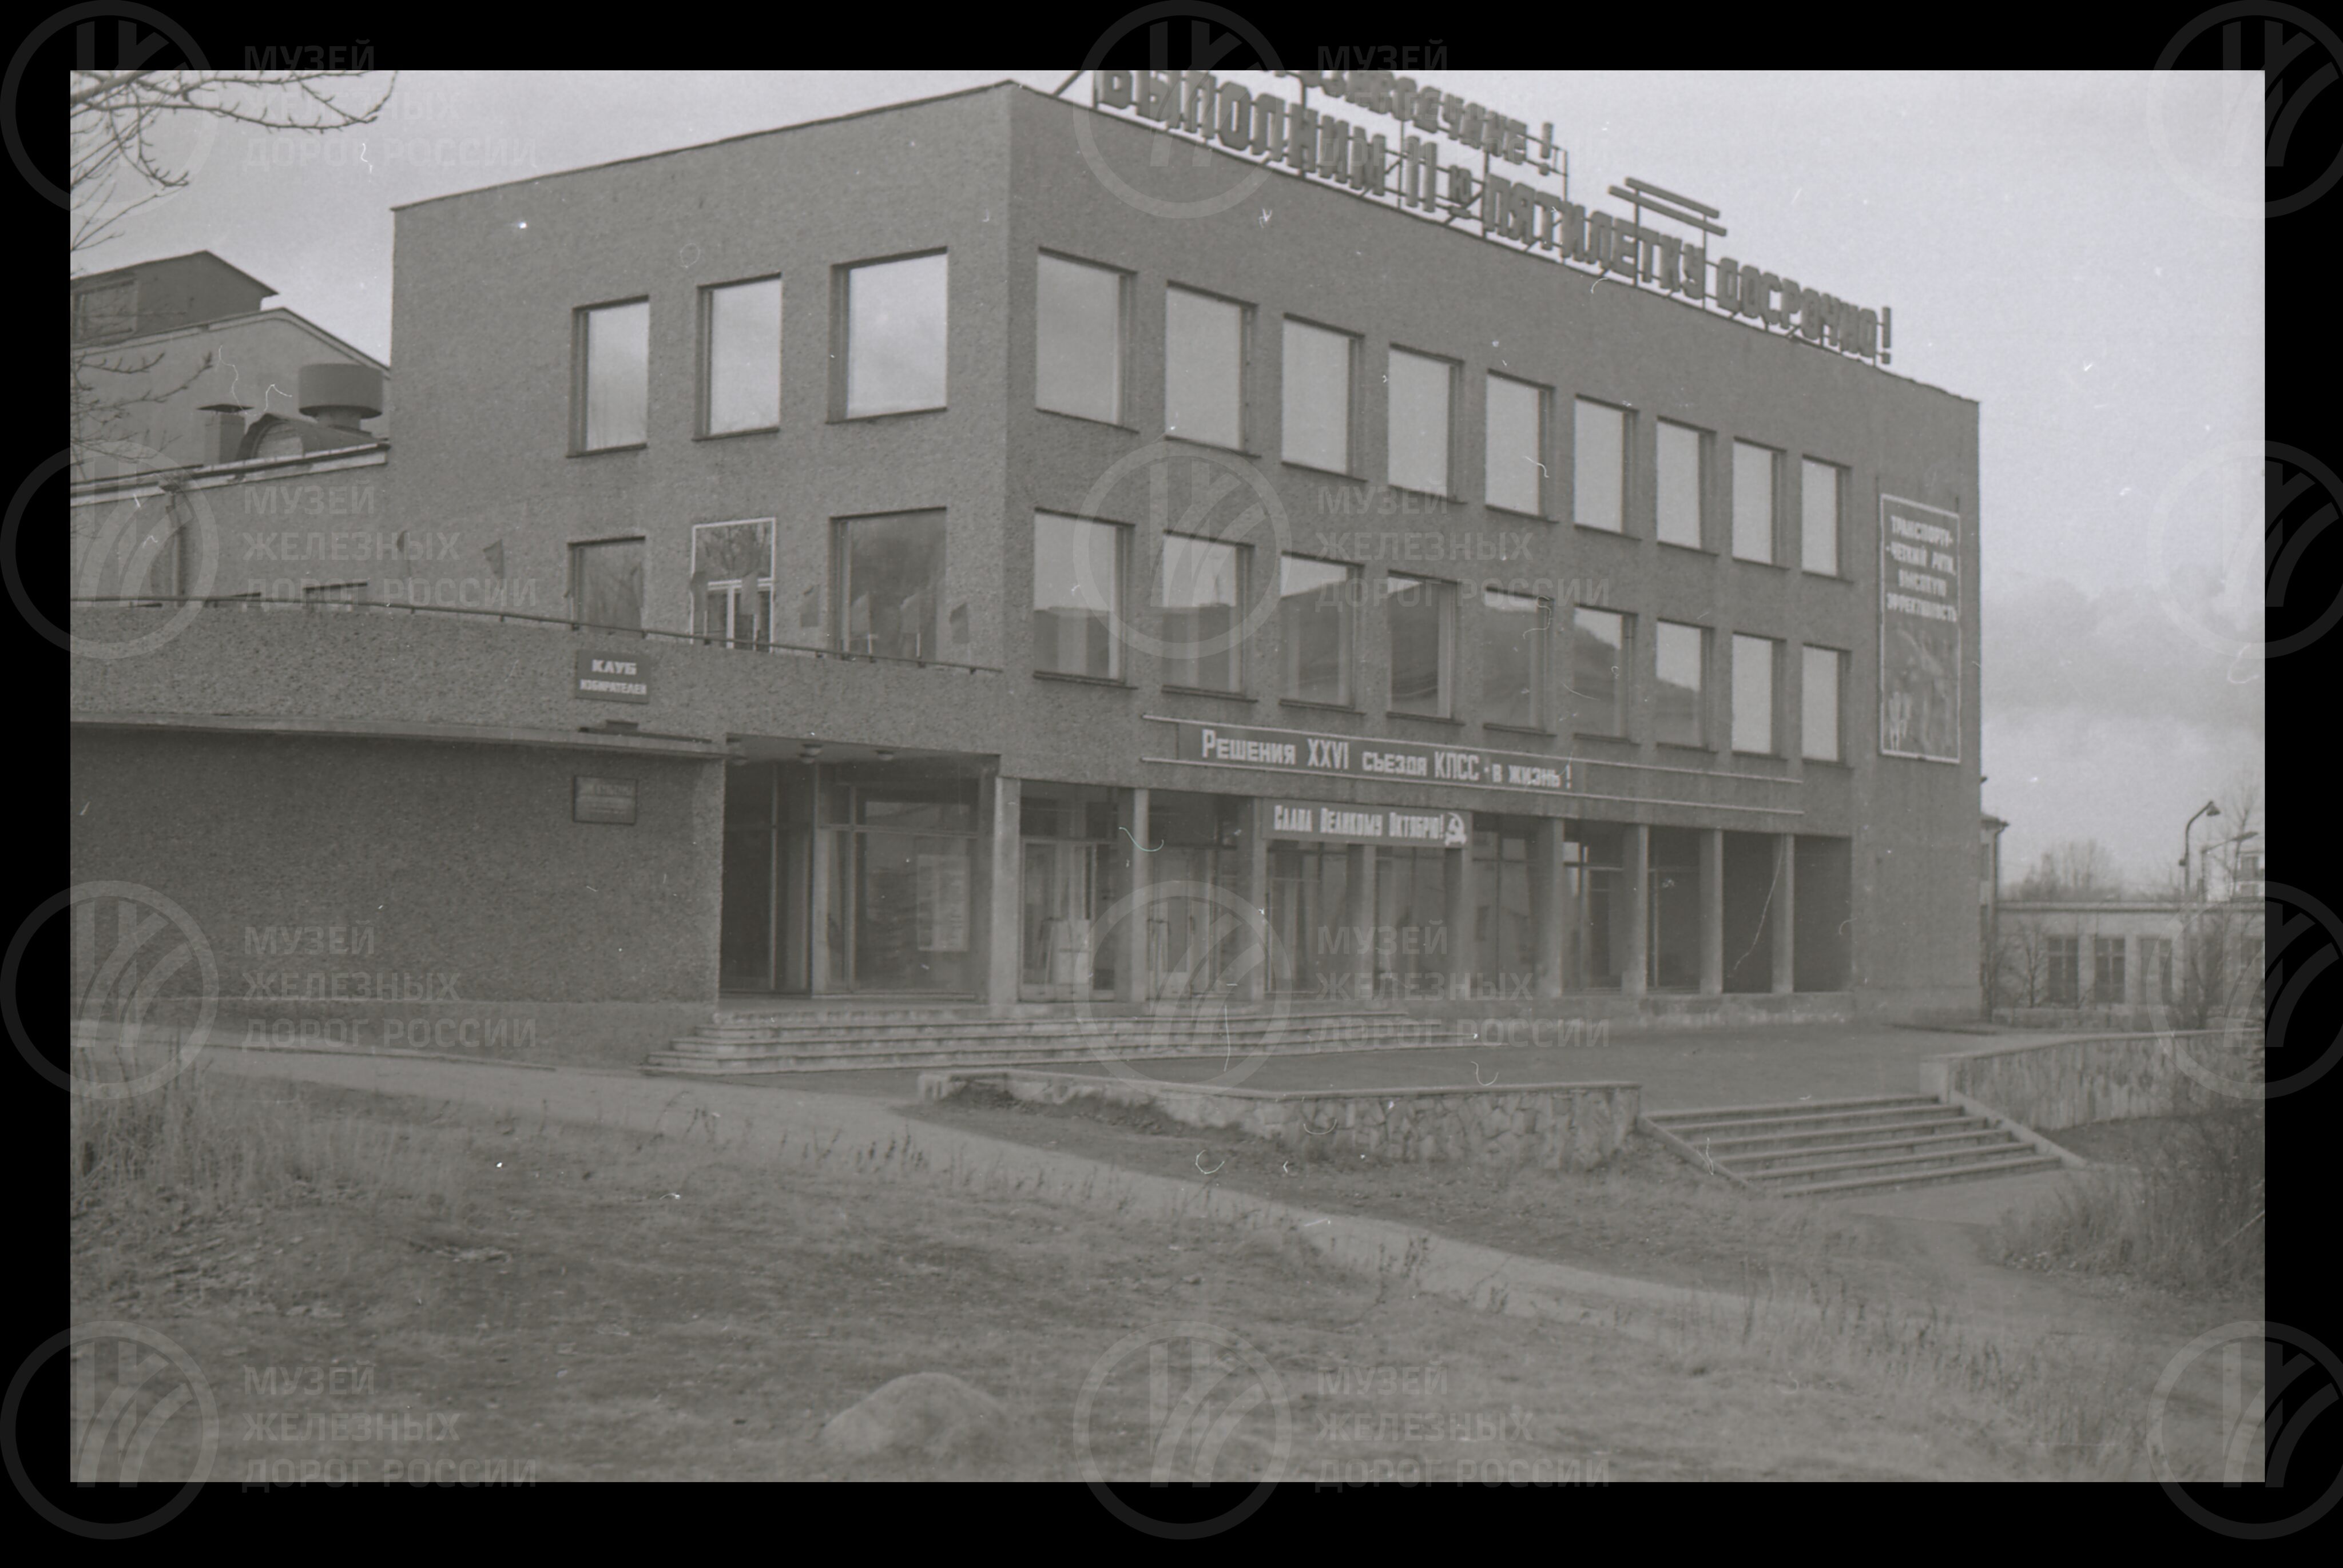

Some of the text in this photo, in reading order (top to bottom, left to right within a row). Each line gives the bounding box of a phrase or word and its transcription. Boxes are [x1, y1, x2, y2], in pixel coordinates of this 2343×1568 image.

[1482, 174, 1707, 300] ПЯТИЛЕТКУ
[591, 659, 637, 675] КЛУБ
[1307, 738, 1349, 770] XXVI
[1434, 751, 1480, 781] КПСС
